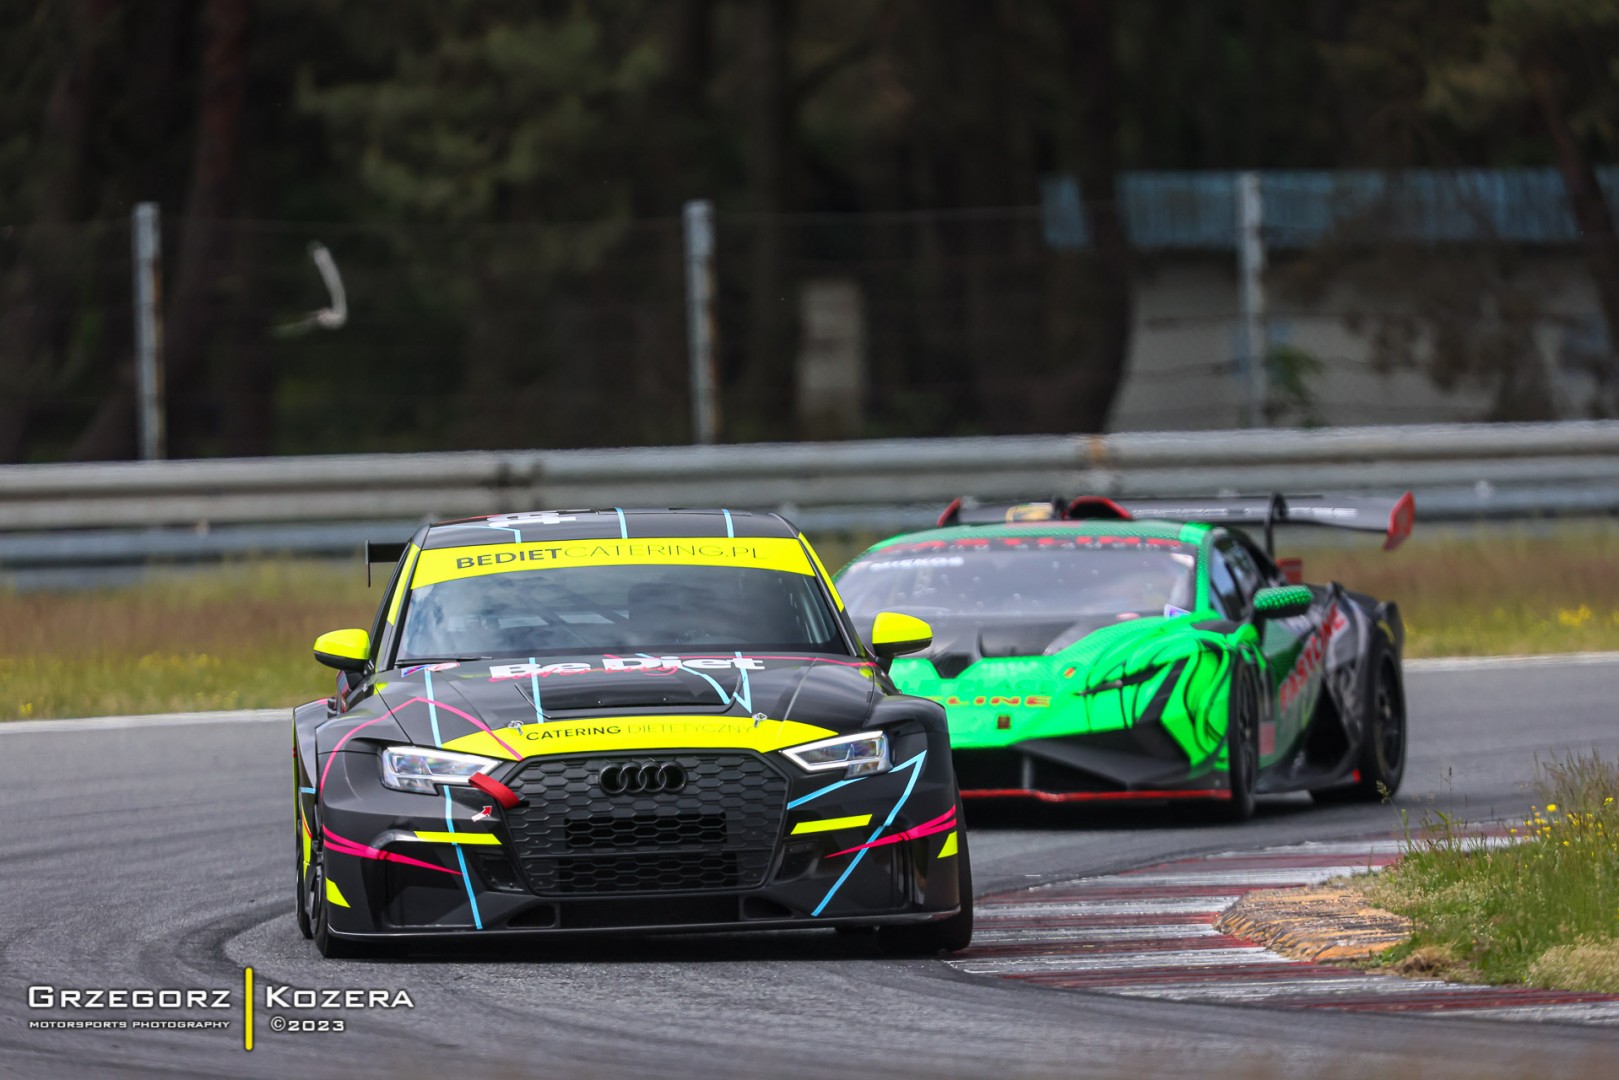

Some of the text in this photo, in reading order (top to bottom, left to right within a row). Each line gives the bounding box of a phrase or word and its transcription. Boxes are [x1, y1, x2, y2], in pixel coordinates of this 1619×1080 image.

[456, 544, 766, 569] BEDIETCATERING.PL
[489, 655, 765, 679] Be Diet
[526, 722, 752, 741] CATERING DIETETYCZNY
